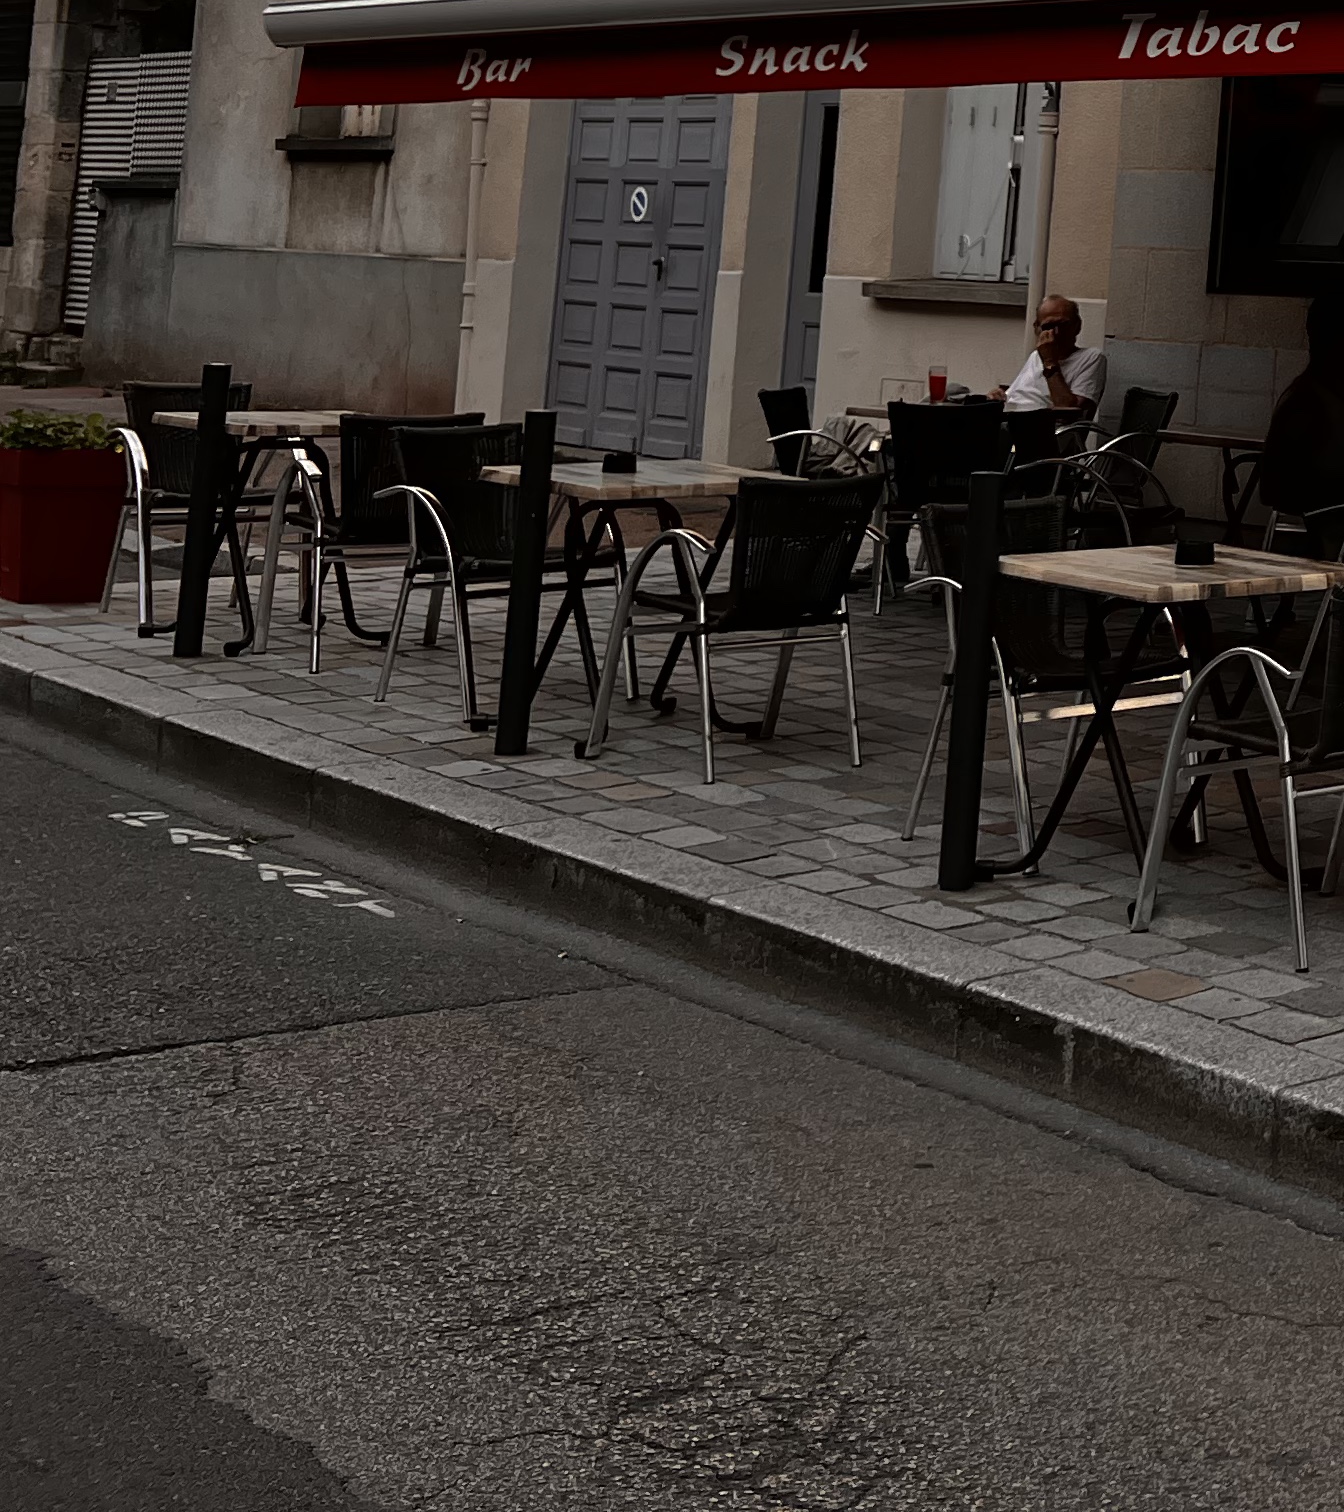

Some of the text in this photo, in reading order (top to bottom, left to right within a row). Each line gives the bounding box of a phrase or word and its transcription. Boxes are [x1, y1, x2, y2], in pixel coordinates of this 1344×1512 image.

[715, 29, 870, 79] Snack
[1117, 9, 1301, 60] Tabac
[457, 47, 532, 91] Bar
